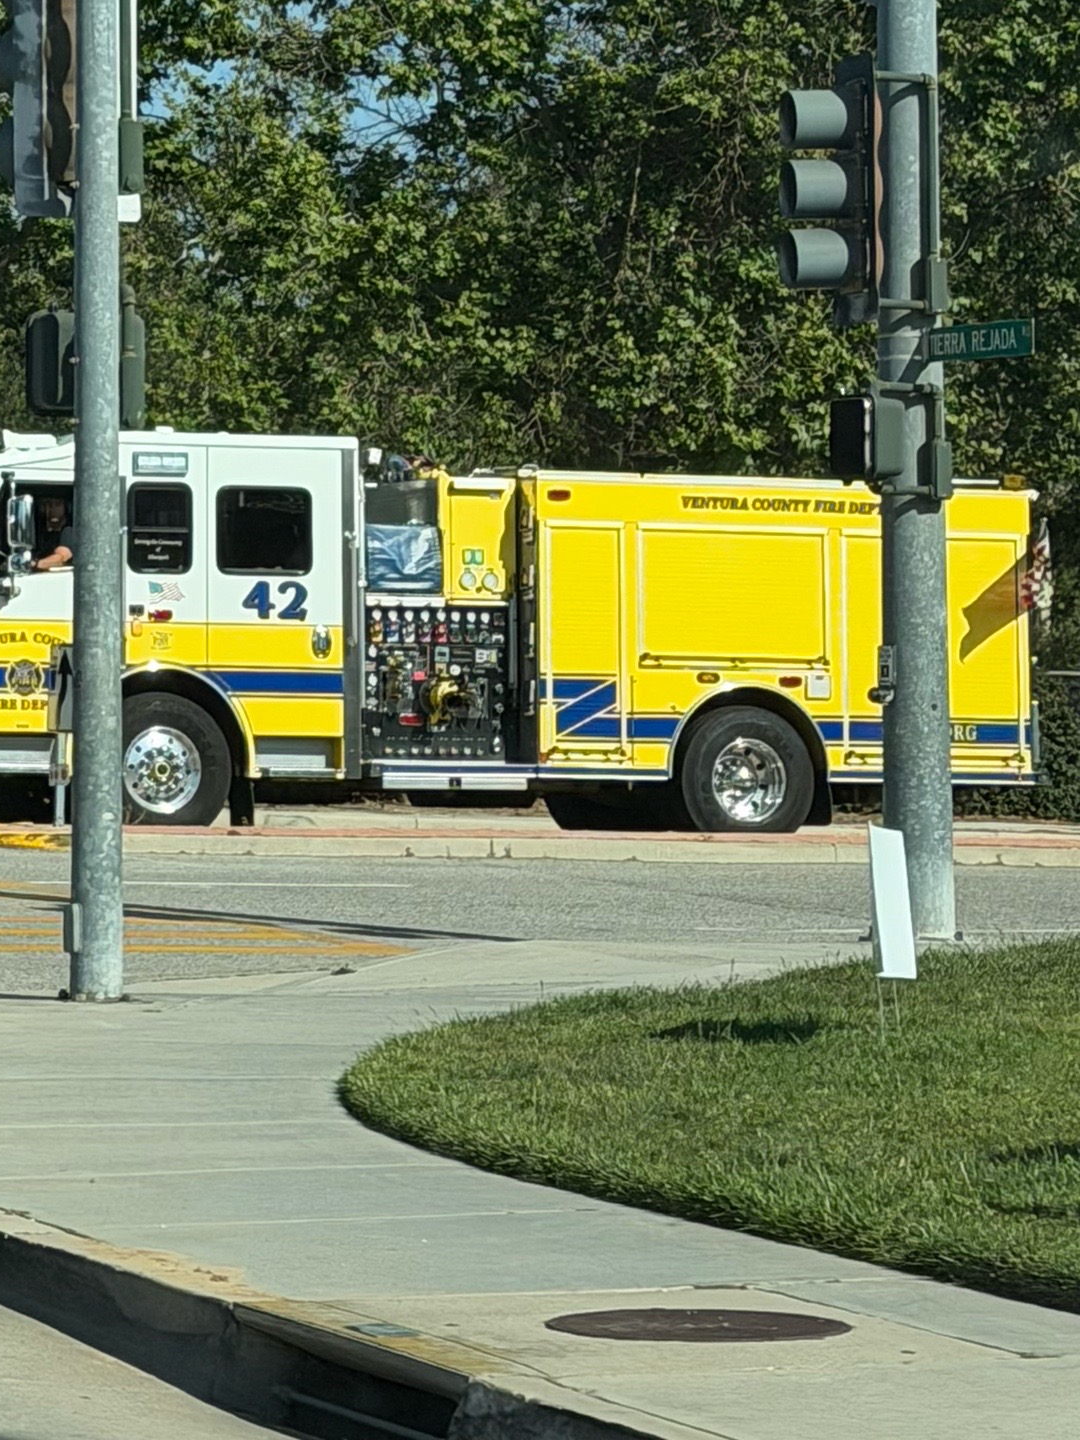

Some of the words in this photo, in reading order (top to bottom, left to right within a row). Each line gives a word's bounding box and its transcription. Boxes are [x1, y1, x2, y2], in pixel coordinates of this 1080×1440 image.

[930, 331, 967, 356] TIERRA
[971, 326, 1018, 352] REJADA
[681, 495, 749, 511] VENTURA
[751, 497, 811, 513] COUNTY
[813, 499, 846, 514] FIRE
[242, 580, 308, 622] 42
[20, 699, 49, 712] DEP
[949, 724, 978, 741] RG
